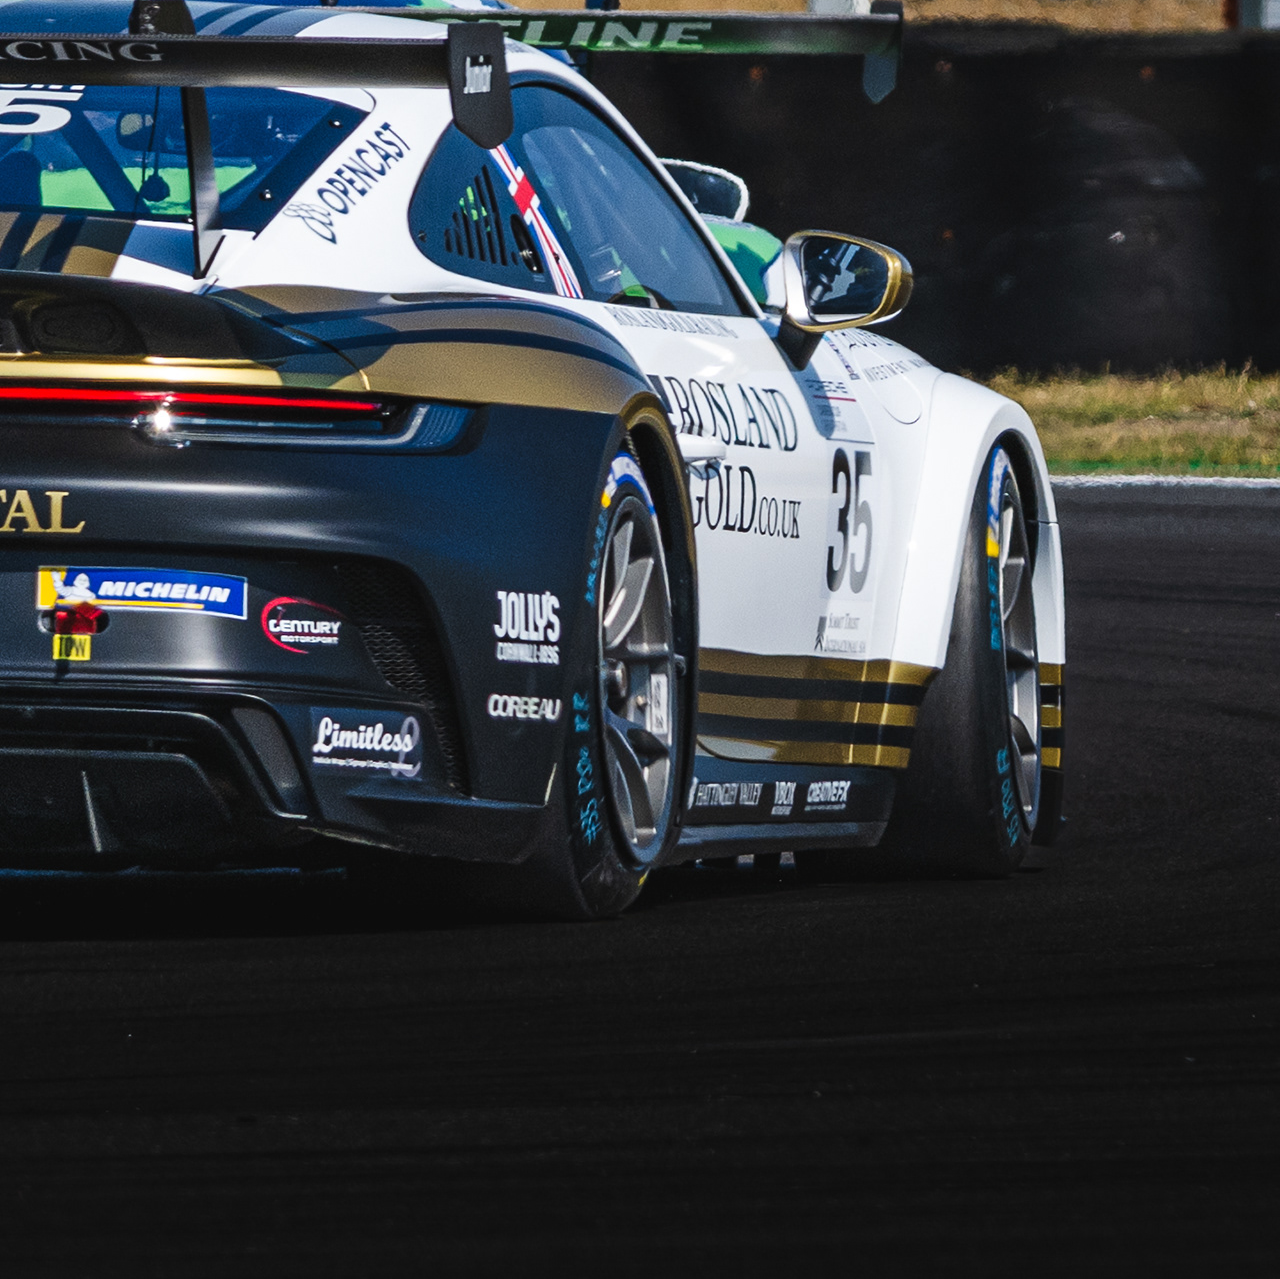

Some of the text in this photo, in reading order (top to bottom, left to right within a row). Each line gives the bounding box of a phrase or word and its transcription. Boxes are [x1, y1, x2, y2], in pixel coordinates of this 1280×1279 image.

[317, 122, 410, 215] OPENCAST
[665, 376, 798, 452] ROSLAND
[826, 447, 873, 594] 35
[98, 581, 231, 603] MICHELIN
[268, 619, 342, 634] CENTURY
[493, 590, 561, 643] JOLLY'S
[58, 635, 88, 657] TOW
[487, 693, 562, 720] CORBEAU
[312, 716, 414, 753] Limitless
